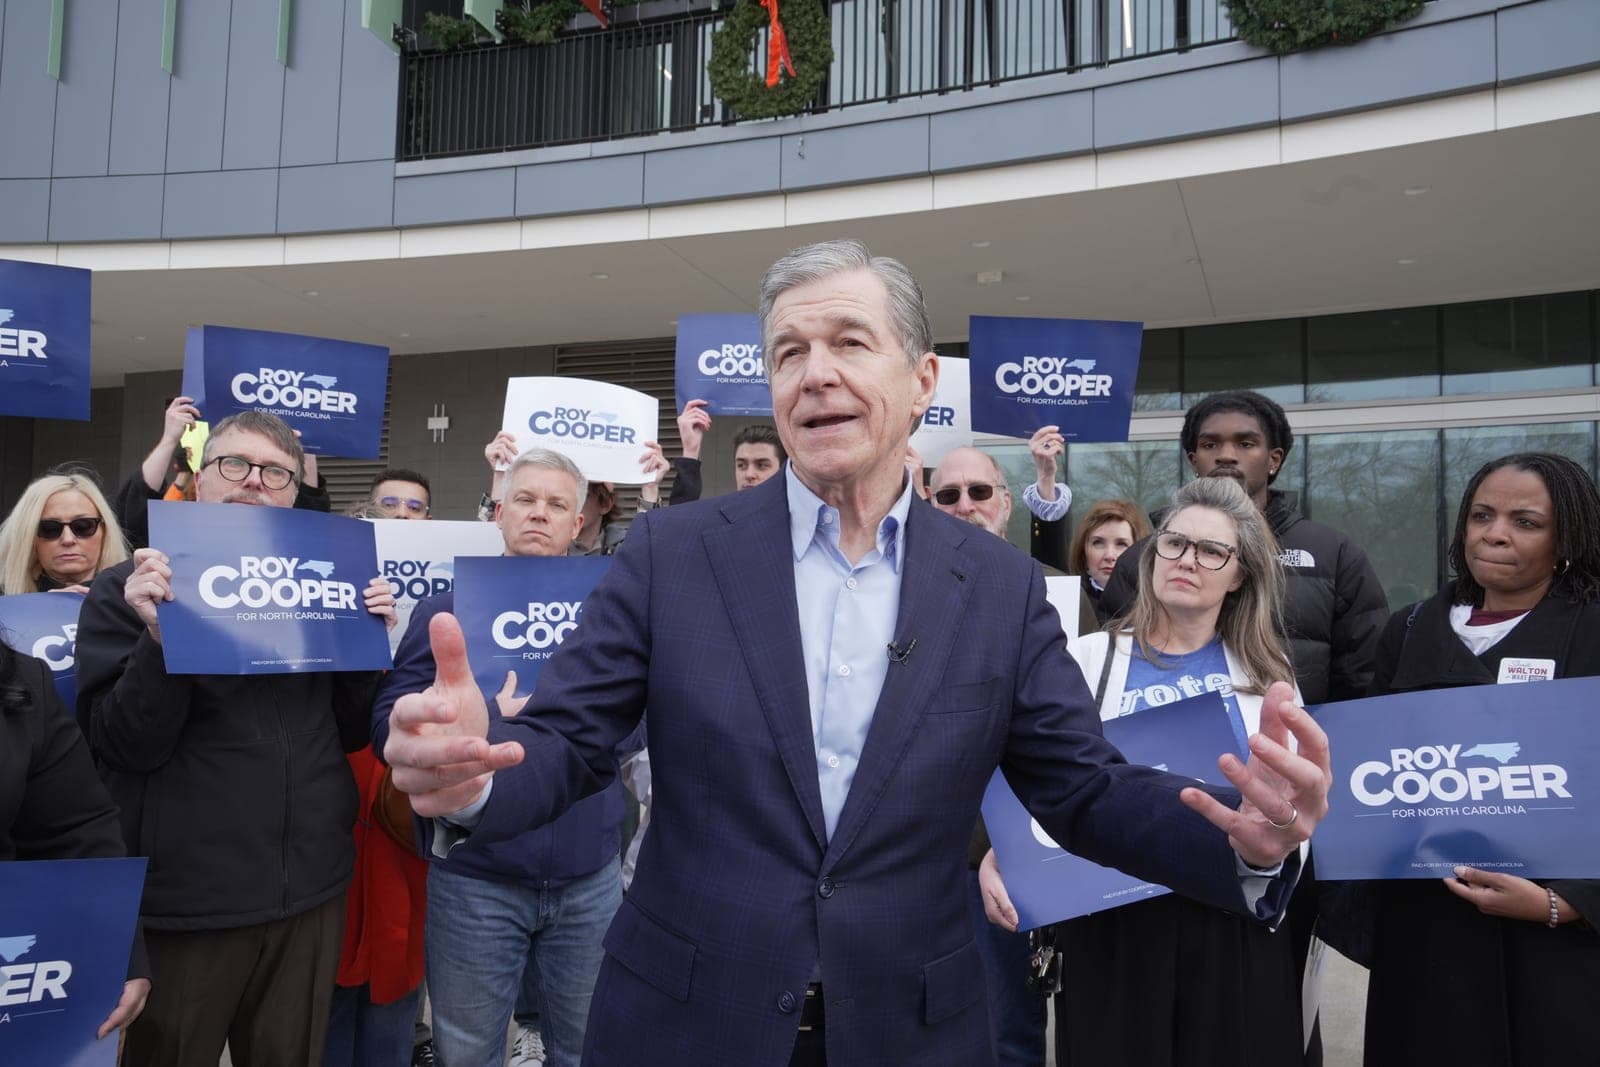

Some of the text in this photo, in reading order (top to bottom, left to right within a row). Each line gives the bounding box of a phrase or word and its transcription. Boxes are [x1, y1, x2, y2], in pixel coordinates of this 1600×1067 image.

[721, 344, 758, 358] ROY
[1023, 356, 1068, 374] ROY
[259, 367, 305, 387] ROY
[995, 362, 1113, 397] COOPER
[231, 372, 358, 414] COOPER
[1016, 396, 1031, 404] FOR
[1032, 397, 1057, 405] NORTH
[268, 407, 294, 416] NORTH
[294, 410, 331, 420] CAROLINA
[554, 407, 591, 421] ROY
[528, 410, 637, 444] COOPER
[240, 556, 300, 579] ROY
[383, 560, 431, 577] ROY
[198, 565, 359, 610] COOPER
[386, 577, 454, 600] OOP
[236, 611, 336, 621] FOR NORTH CAROLINA
[528, 602, 582, 622] ROY
[492, 611, 579, 650] COO
[522, 652, 541, 660] FOR
[1507, 667, 1548, 675] WALTON
[1390, 743, 1462, 772] ROY
[1350, 761, 1574, 806] COOPER
[1392, 804, 1527, 818] FOR NORTH CAROLINA
[0, 960, 73, 1006] ER
